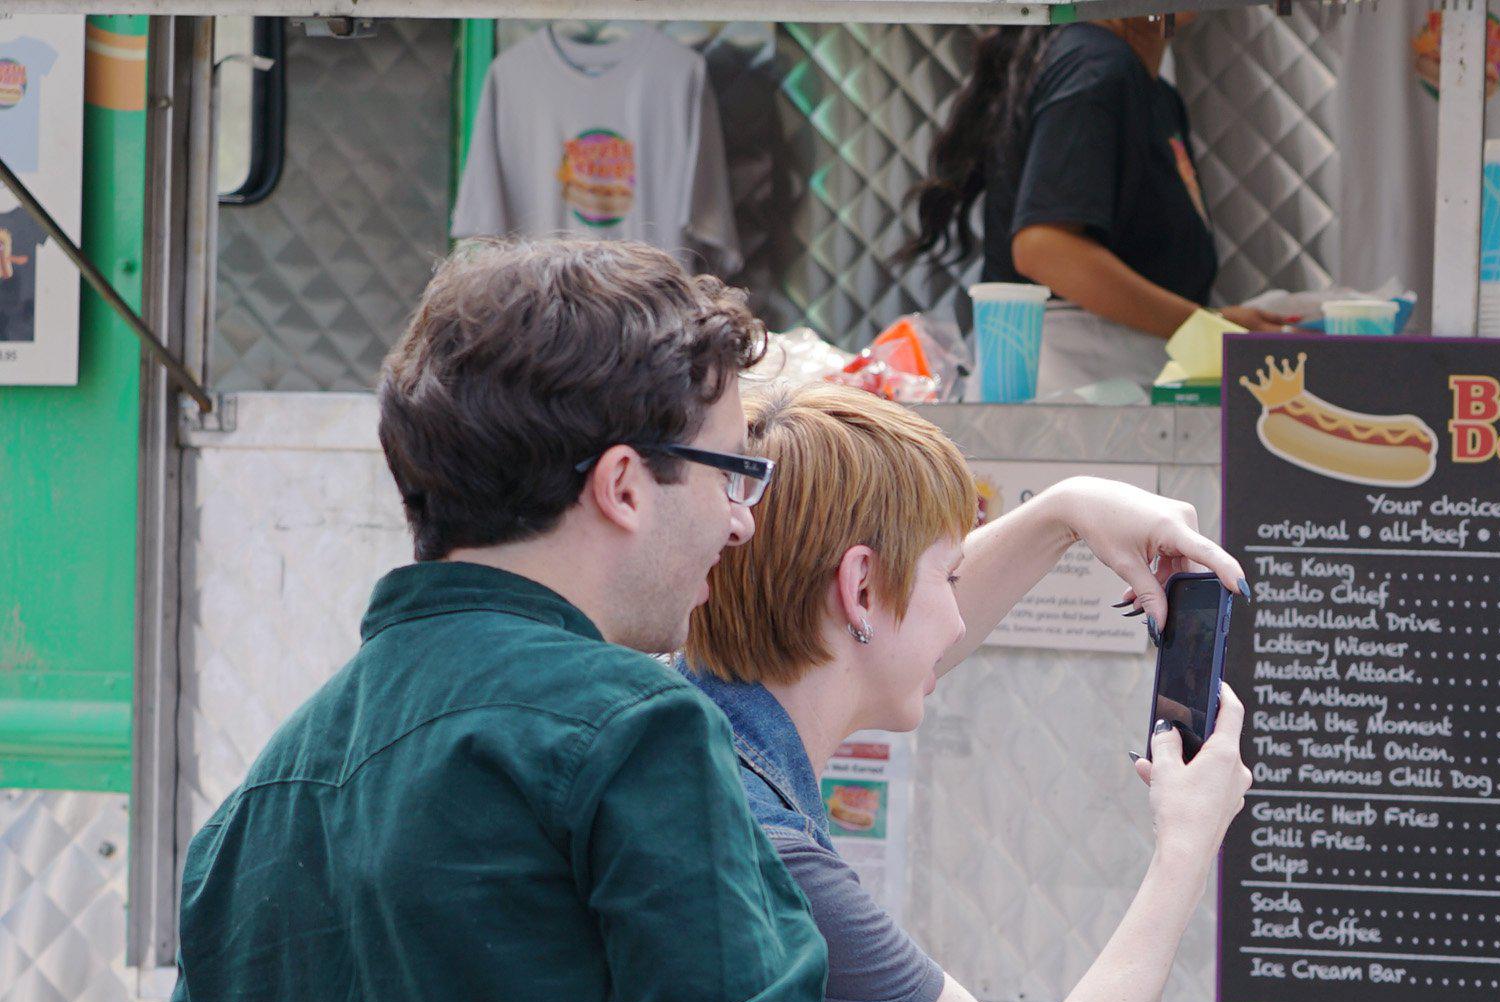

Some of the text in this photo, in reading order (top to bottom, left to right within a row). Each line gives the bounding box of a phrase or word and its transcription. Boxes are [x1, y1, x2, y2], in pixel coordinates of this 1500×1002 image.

[1366, 493, 1422, 517] Your
[1257, 520, 1349, 547] original
[1379, 520, 1469, 548] all-beef
[1254, 556, 1296, 577] The
[1301, 557, 1355, 584] Kang
[1254, 580, 1325, 602] Studio
[1330, 580, 1390, 610] Chief
[1254, 607, 1380, 630] Mulholland
[1385, 612, 1442, 633] Drive
[1253, 632, 1330, 665] Lottery
[1335, 635, 1409, 657] Wiener
[1253, 658, 1341, 681] Mustard
[1345, 661, 1415, 683] Attack
[1253, 684, 1294, 705] The
[1298, 686, 1388, 718] Anthony
[1252, 710, 1318, 732] Relish
[1324, 711, 1359, 734] the
[1365, 714, 1453, 737] Moment
[1252, 735, 1294, 757] The
[1297, 734, 1376, 764] Tearful
[1383, 740, 1450, 762] Onion
[1252, 761, 1293, 783] Our
[1298, 763, 1383, 785] Famous
[1388, 765, 1444, 789] Chili
[1450, 768, 1493, 797] Dog
[1251, 801, 1325, 823] Garlic
[1332, 802, 1378, 826] Herb
[1384, 806, 1440, 828] Fries
[1251, 826, 1305, 848] Chili
[1311, 829, 1366, 850] Fries
[1251, 852, 1309, 883] Chips
[1250, 890, 1304, 914] Soda
[1250, 916, 1303, 939] Iced
[1307, 917, 1383, 946] Coffee
[1250, 957, 1286, 978] Ice
[1292, 959, 1363, 981] Cream
[1369, 962, 1407, 984] Bar
